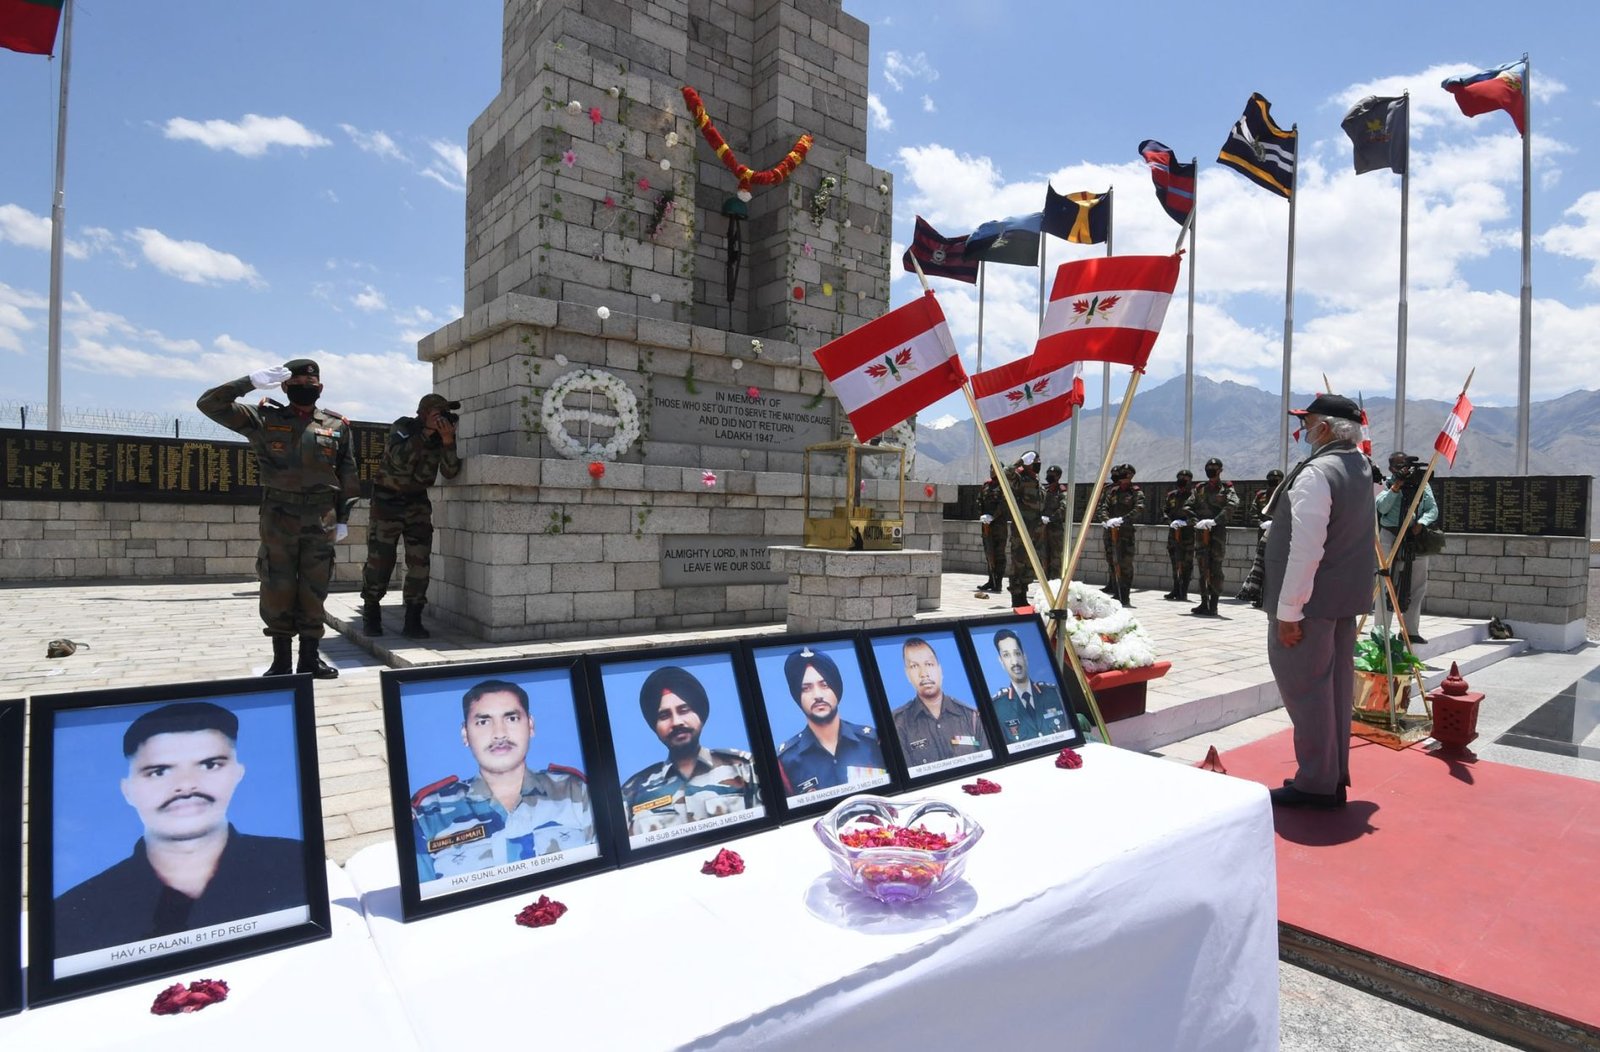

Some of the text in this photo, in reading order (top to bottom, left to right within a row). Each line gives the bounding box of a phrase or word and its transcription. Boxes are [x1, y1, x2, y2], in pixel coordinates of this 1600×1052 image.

[715, 391, 782, 408] IN MEMORY OF
[654, 397, 832, 426] THOSE WHO SET OUT TO SERVE THE NATIONS CAUSE
[699, 415, 720, 426] AND
[721, 418, 737, 428] DID
[738, 419, 757, 430] NOT
[715, 430, 752, 442] LADAKH
[664, 548, 710, 560] ALMIGHTY
[740, 548, 748, 558] IN
[750, 548, 766, 558] THY
[683, 562, 712, 573] LEAVE
[714, 562, 728, 572] WE
[730, 561, 748, 572] OUR
[656, 832, 670, 840] SUB
[671, 826, 697, 837] SATNAM
[697, 820, 719, 832] SINGH,
[724, 816, 738, 826] MED
[738, 812, 755, 822] REGT
[451, 876, 470, 886] HAV
[471, 870, 496, 882] SUNIL
[497, 862, 528, 876] KUMAR,
[540, 854, 564, 866] BIHAR
[110, 921, 258, 960] HAV K PALANI, 81 FD REGT
